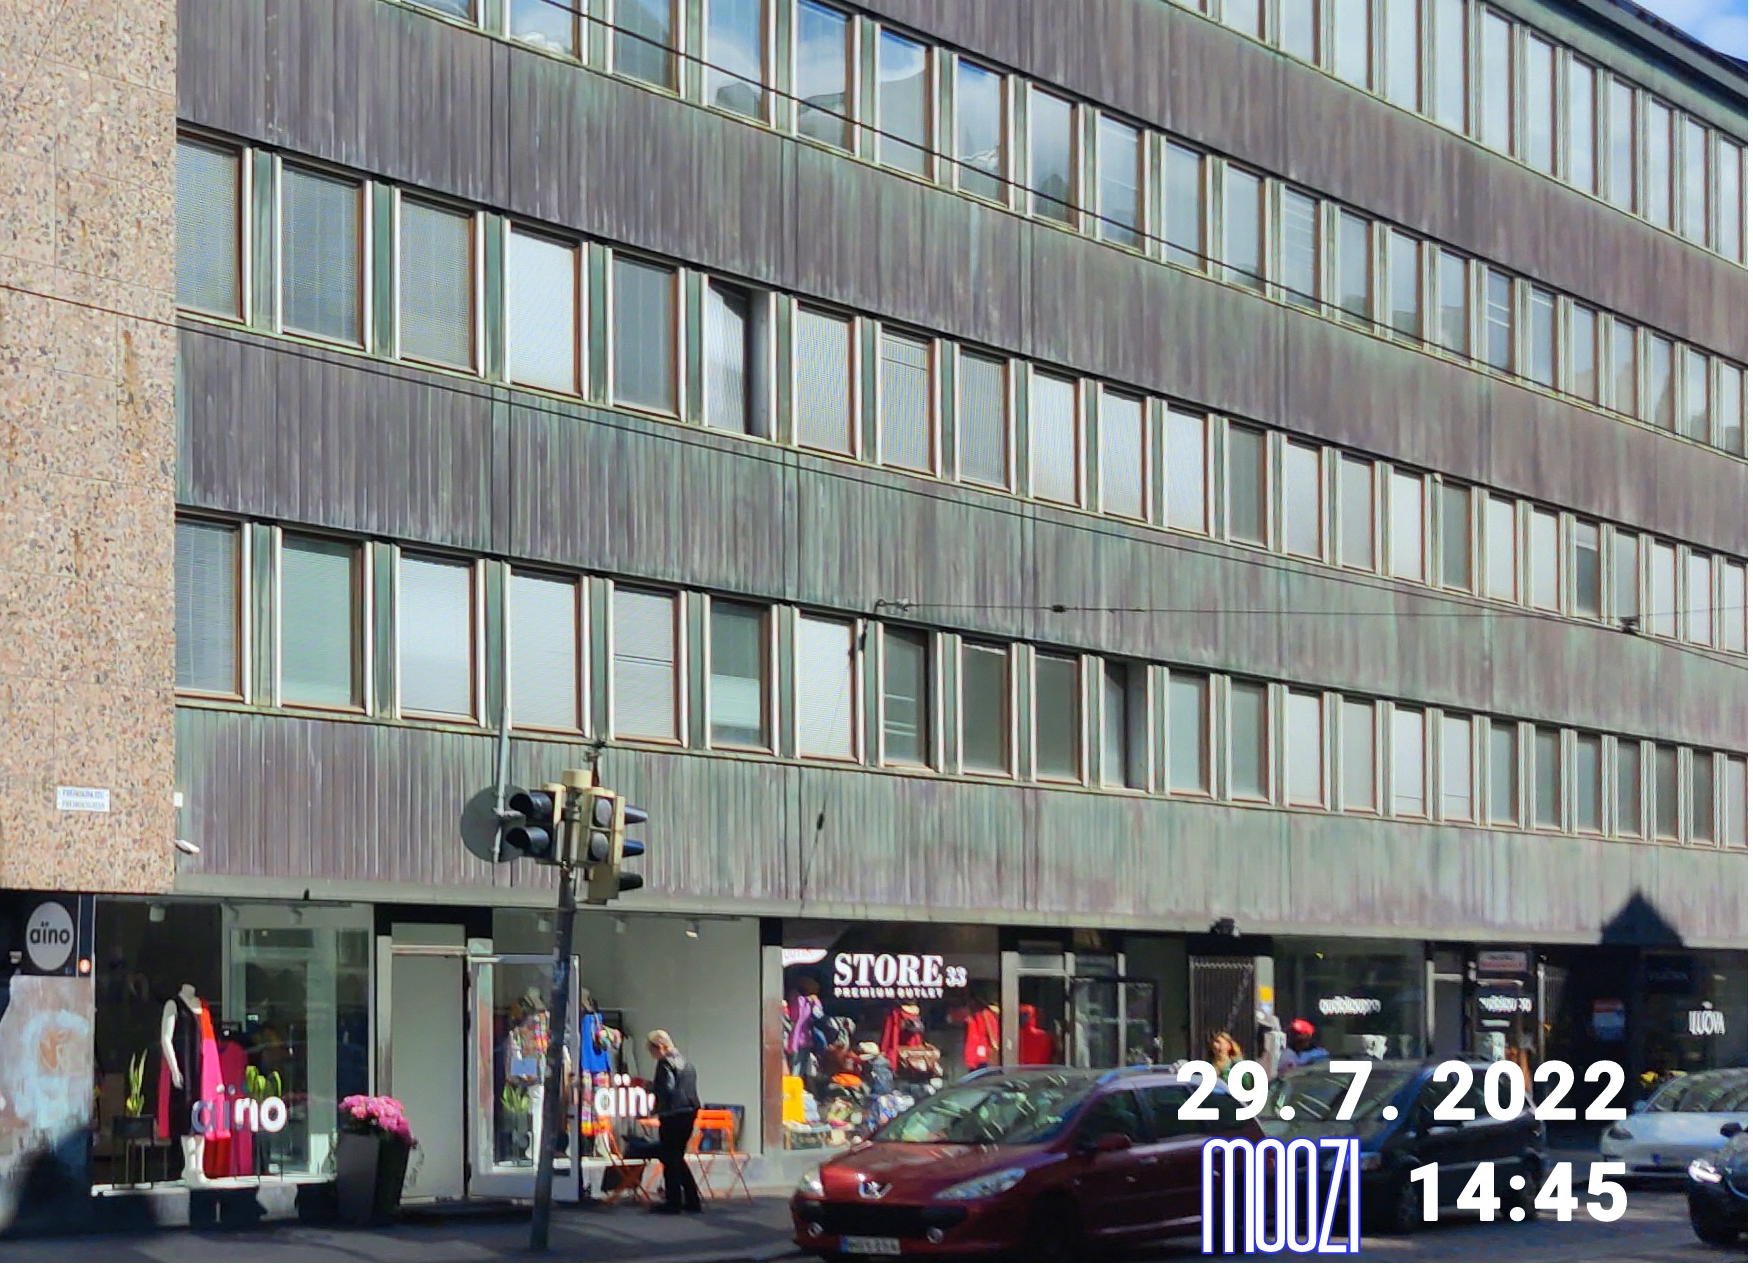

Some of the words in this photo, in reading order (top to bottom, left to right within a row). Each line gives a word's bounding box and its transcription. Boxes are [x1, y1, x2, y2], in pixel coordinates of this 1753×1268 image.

[833, 952, 944, 988] STORE
[834, 987, 895, 999] PREMIUM
[897, 987, 944, 999] OUTLET
